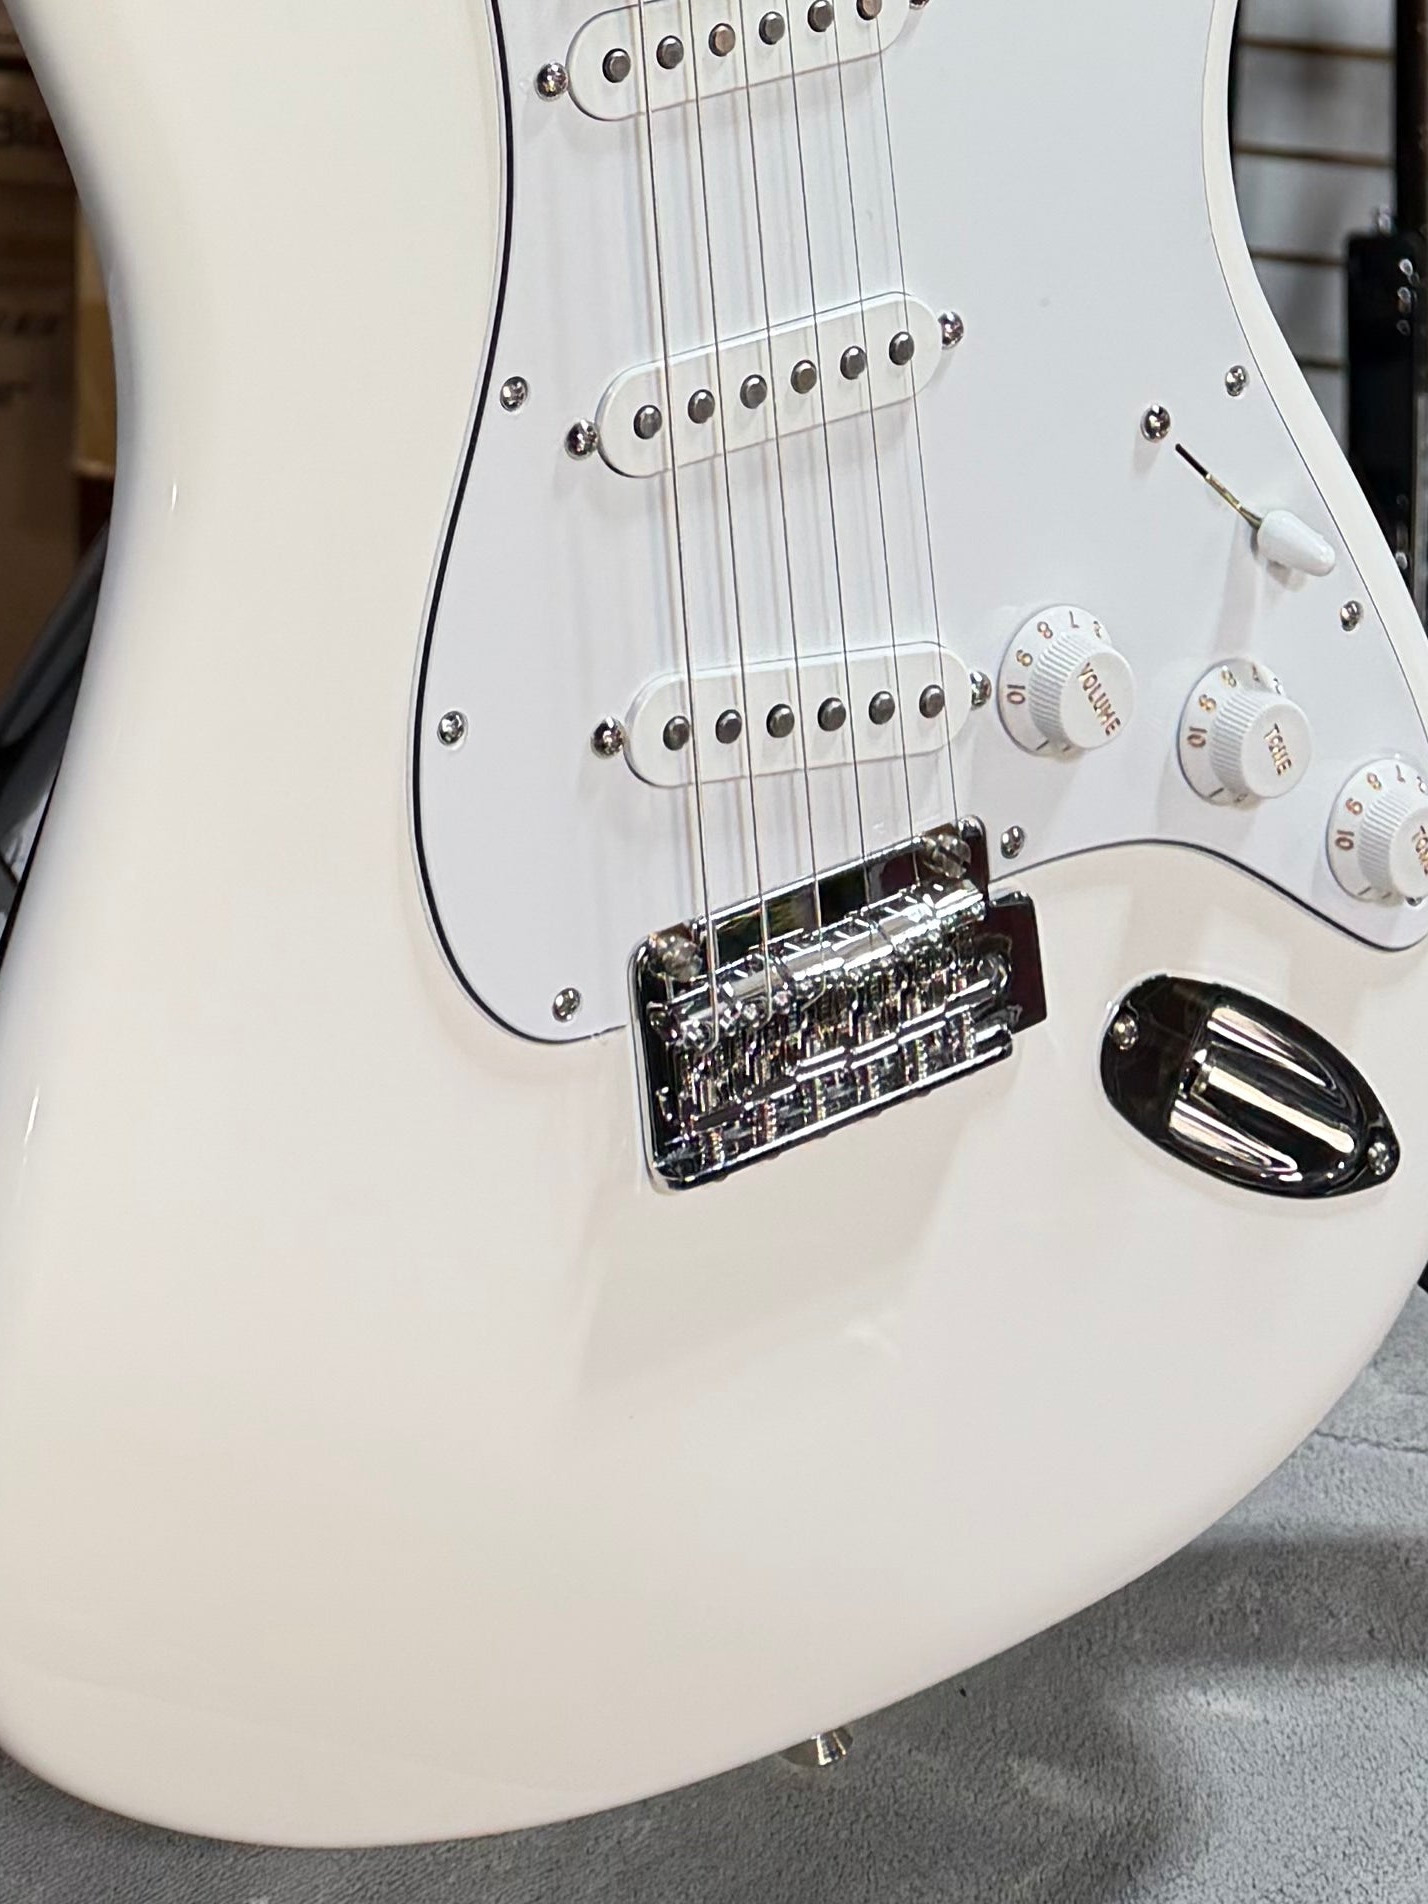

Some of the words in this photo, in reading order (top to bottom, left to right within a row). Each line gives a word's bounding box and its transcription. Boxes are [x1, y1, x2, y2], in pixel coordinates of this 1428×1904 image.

[1006, 683, 1027, 705] 10
[1036, 620, 1054, 640] 8
[1076, 661, 1122, 736] VOLUME
[1186, 726, 1209, 749] 10
[1263, 721, 1293, 777] TONE
[1334, 829, 1356, 852] 10
[1366, 772, 1383, 791] 8
